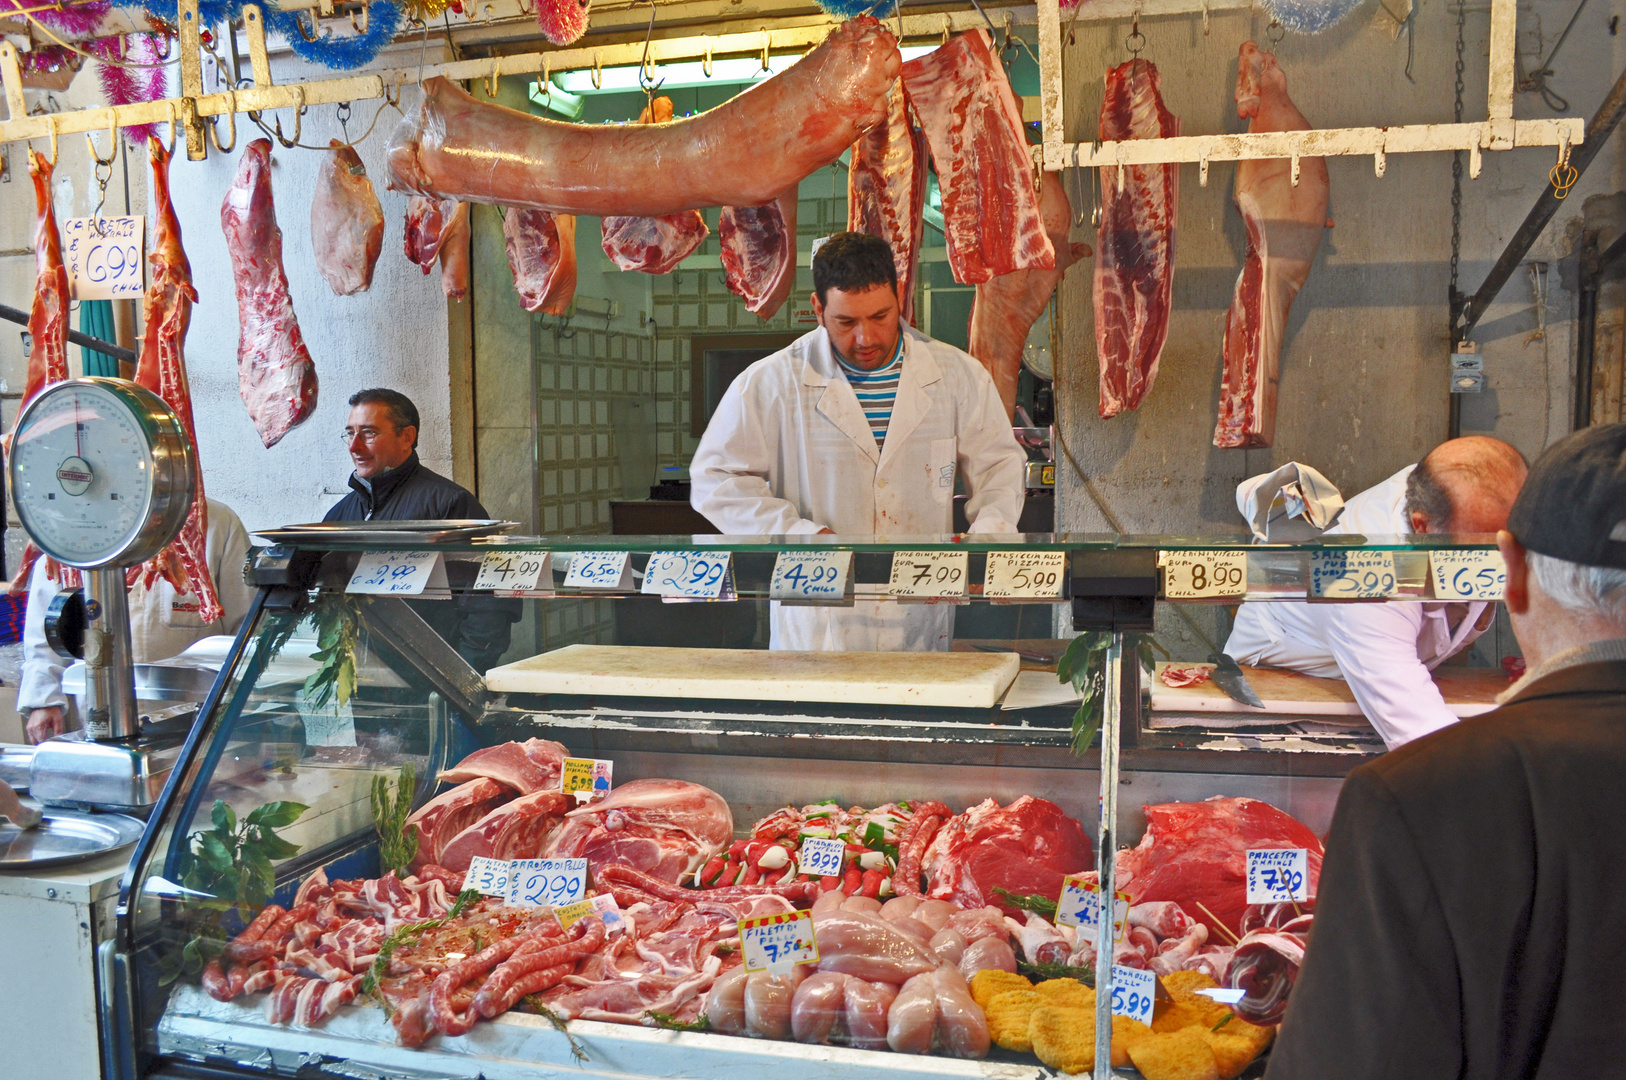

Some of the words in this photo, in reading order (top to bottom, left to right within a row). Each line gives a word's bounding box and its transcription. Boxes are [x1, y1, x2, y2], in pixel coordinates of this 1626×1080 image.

[493, 557, 540, 583] 4,99
[580, 561, 616, 578] 6,50
[661, 556, 724, 591] 2,99
[784, 563, 838, 590] 4,99
[912, 564, 962, 586] 7,99
[1012, 568, 1057, 589] 5,99
[1191, 563, 1243, 590] 8,99
[1336, 569, 1395, 593] 5,99
[473, 857, 509, 868] PUNTIN
[810, 851, 840, 870] 9,99
[1248, 850, 1298, 860] PANCETTA
[524, 874, 581, 906] 2,99
[1261, 868, 1303, 893] 7,99
[1112, 986, 1151, 1016] 5,99
